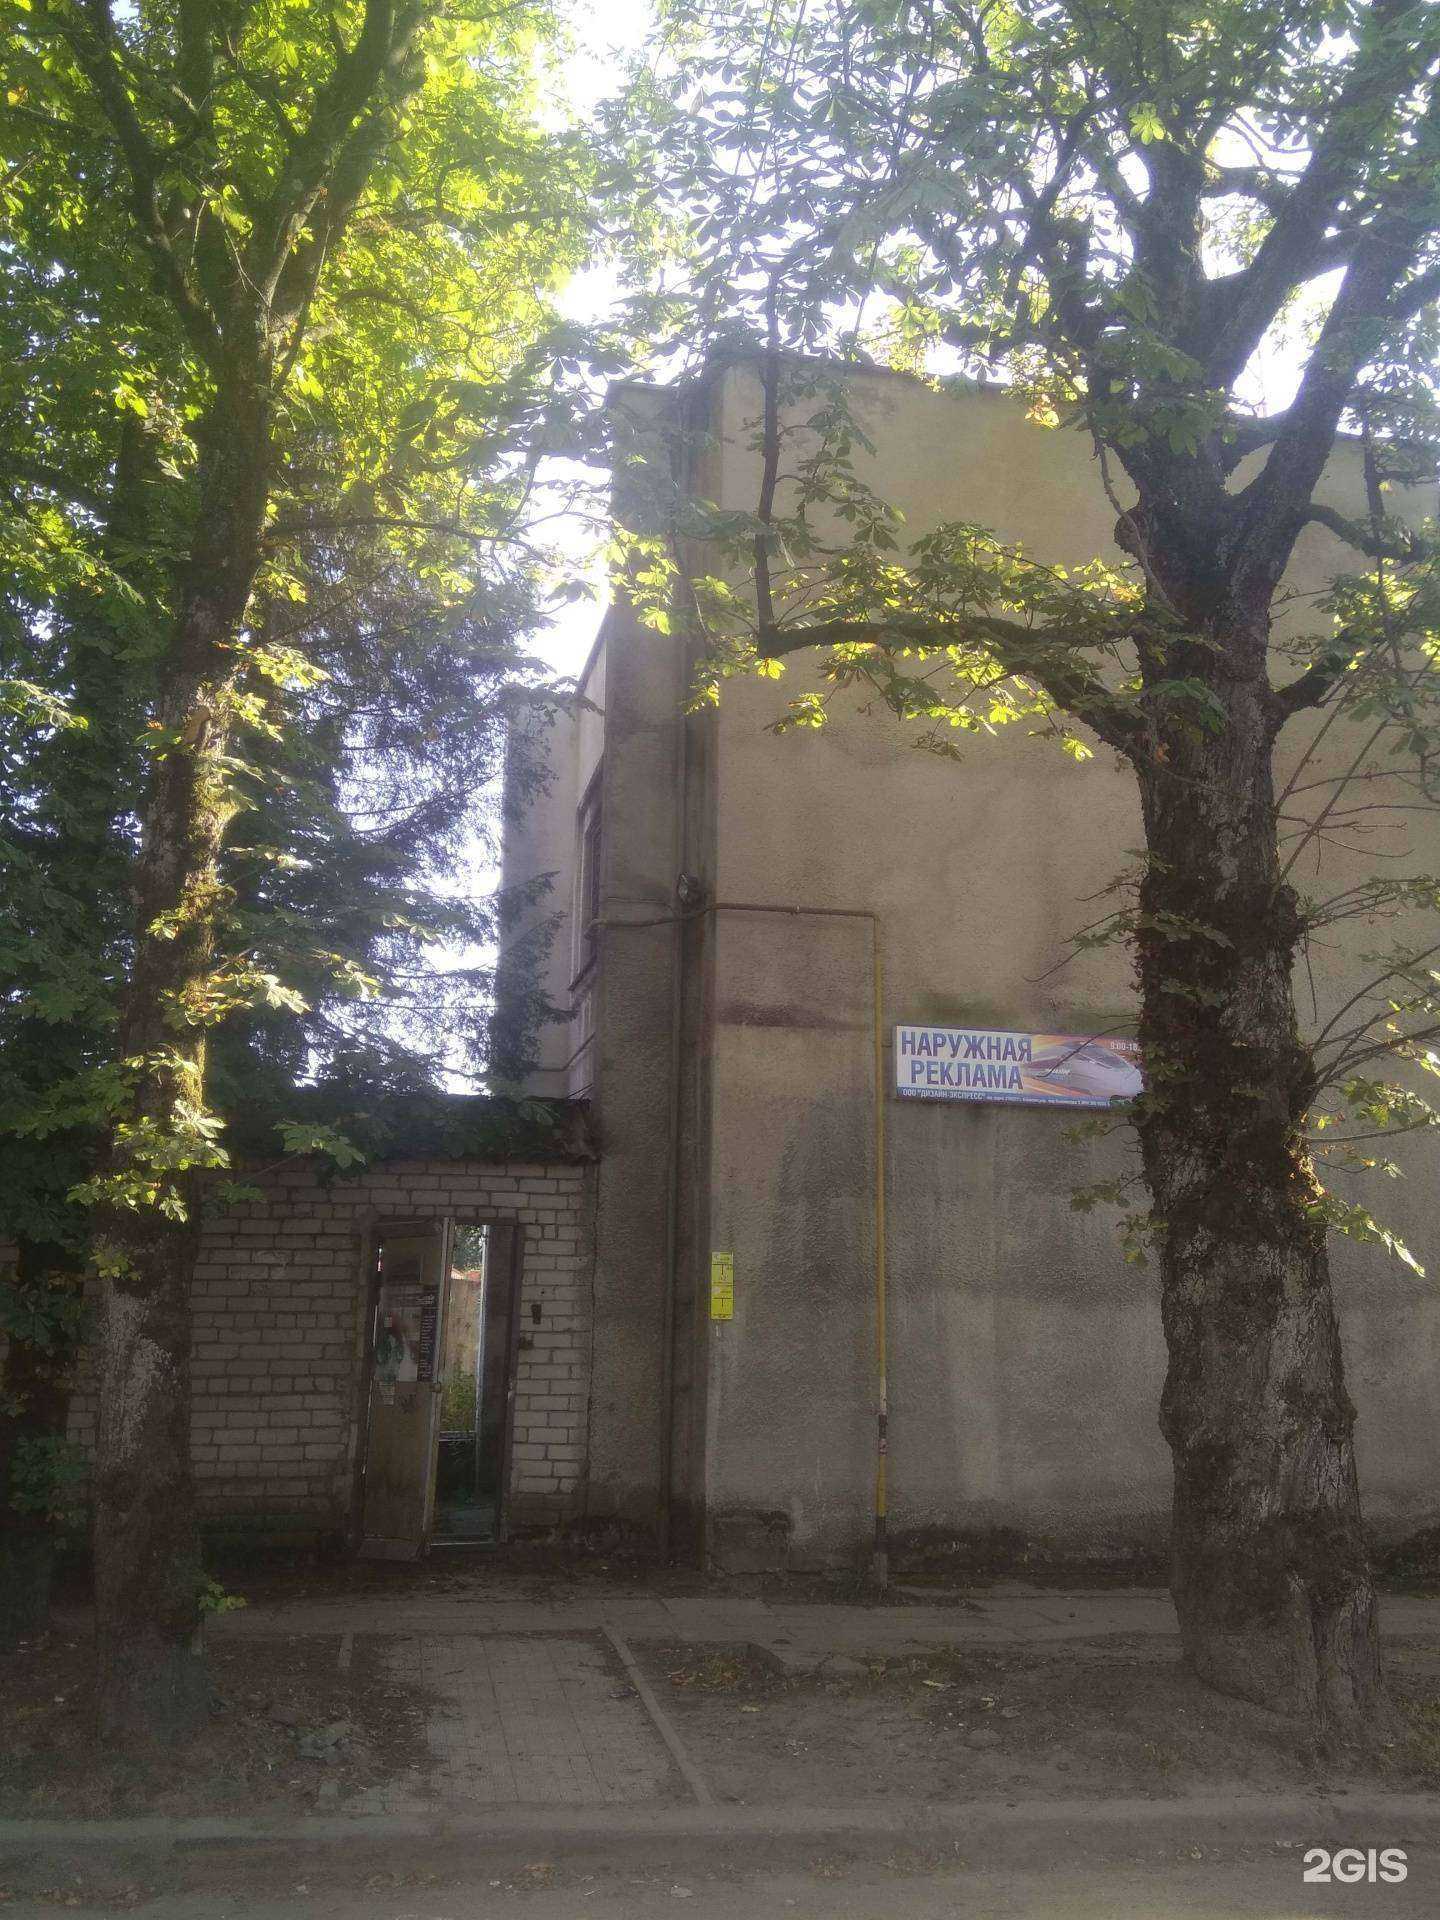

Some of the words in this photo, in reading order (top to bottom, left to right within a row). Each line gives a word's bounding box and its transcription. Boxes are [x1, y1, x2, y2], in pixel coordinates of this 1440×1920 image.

[901, 1031, 1032, 1062] НАРУЖНАЯ
[911, 1060, 1024, 1089] РЕКЛАМА
[902, 1088, 917, 1097] ООО
